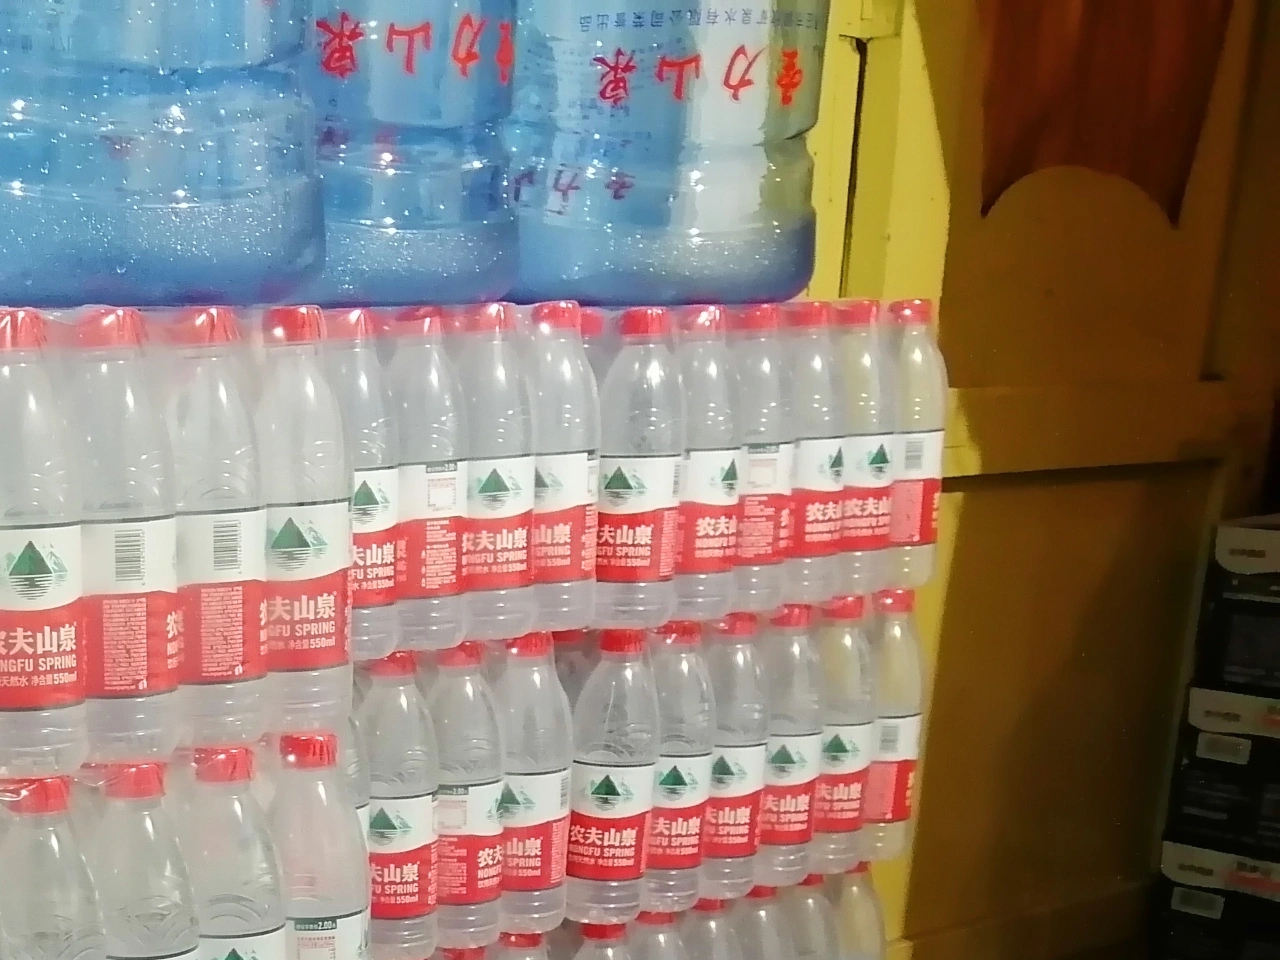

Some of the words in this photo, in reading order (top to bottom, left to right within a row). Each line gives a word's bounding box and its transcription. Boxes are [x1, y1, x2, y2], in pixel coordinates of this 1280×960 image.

[497, 550, 527, 562] SPRING
[616, 545, 651, 556] SPRING
[367, 566, 394, 578] SPRING
[295, 620, 335, 636] SPRING
[39, 653, 76, 669] SPRING
[570, 826, 637, 846] 农夫山泉
[604, 847, 635, 857] SPRING
[507, 858, 541, 867] SPRING
[385, 883, 418, 893] SPRING
